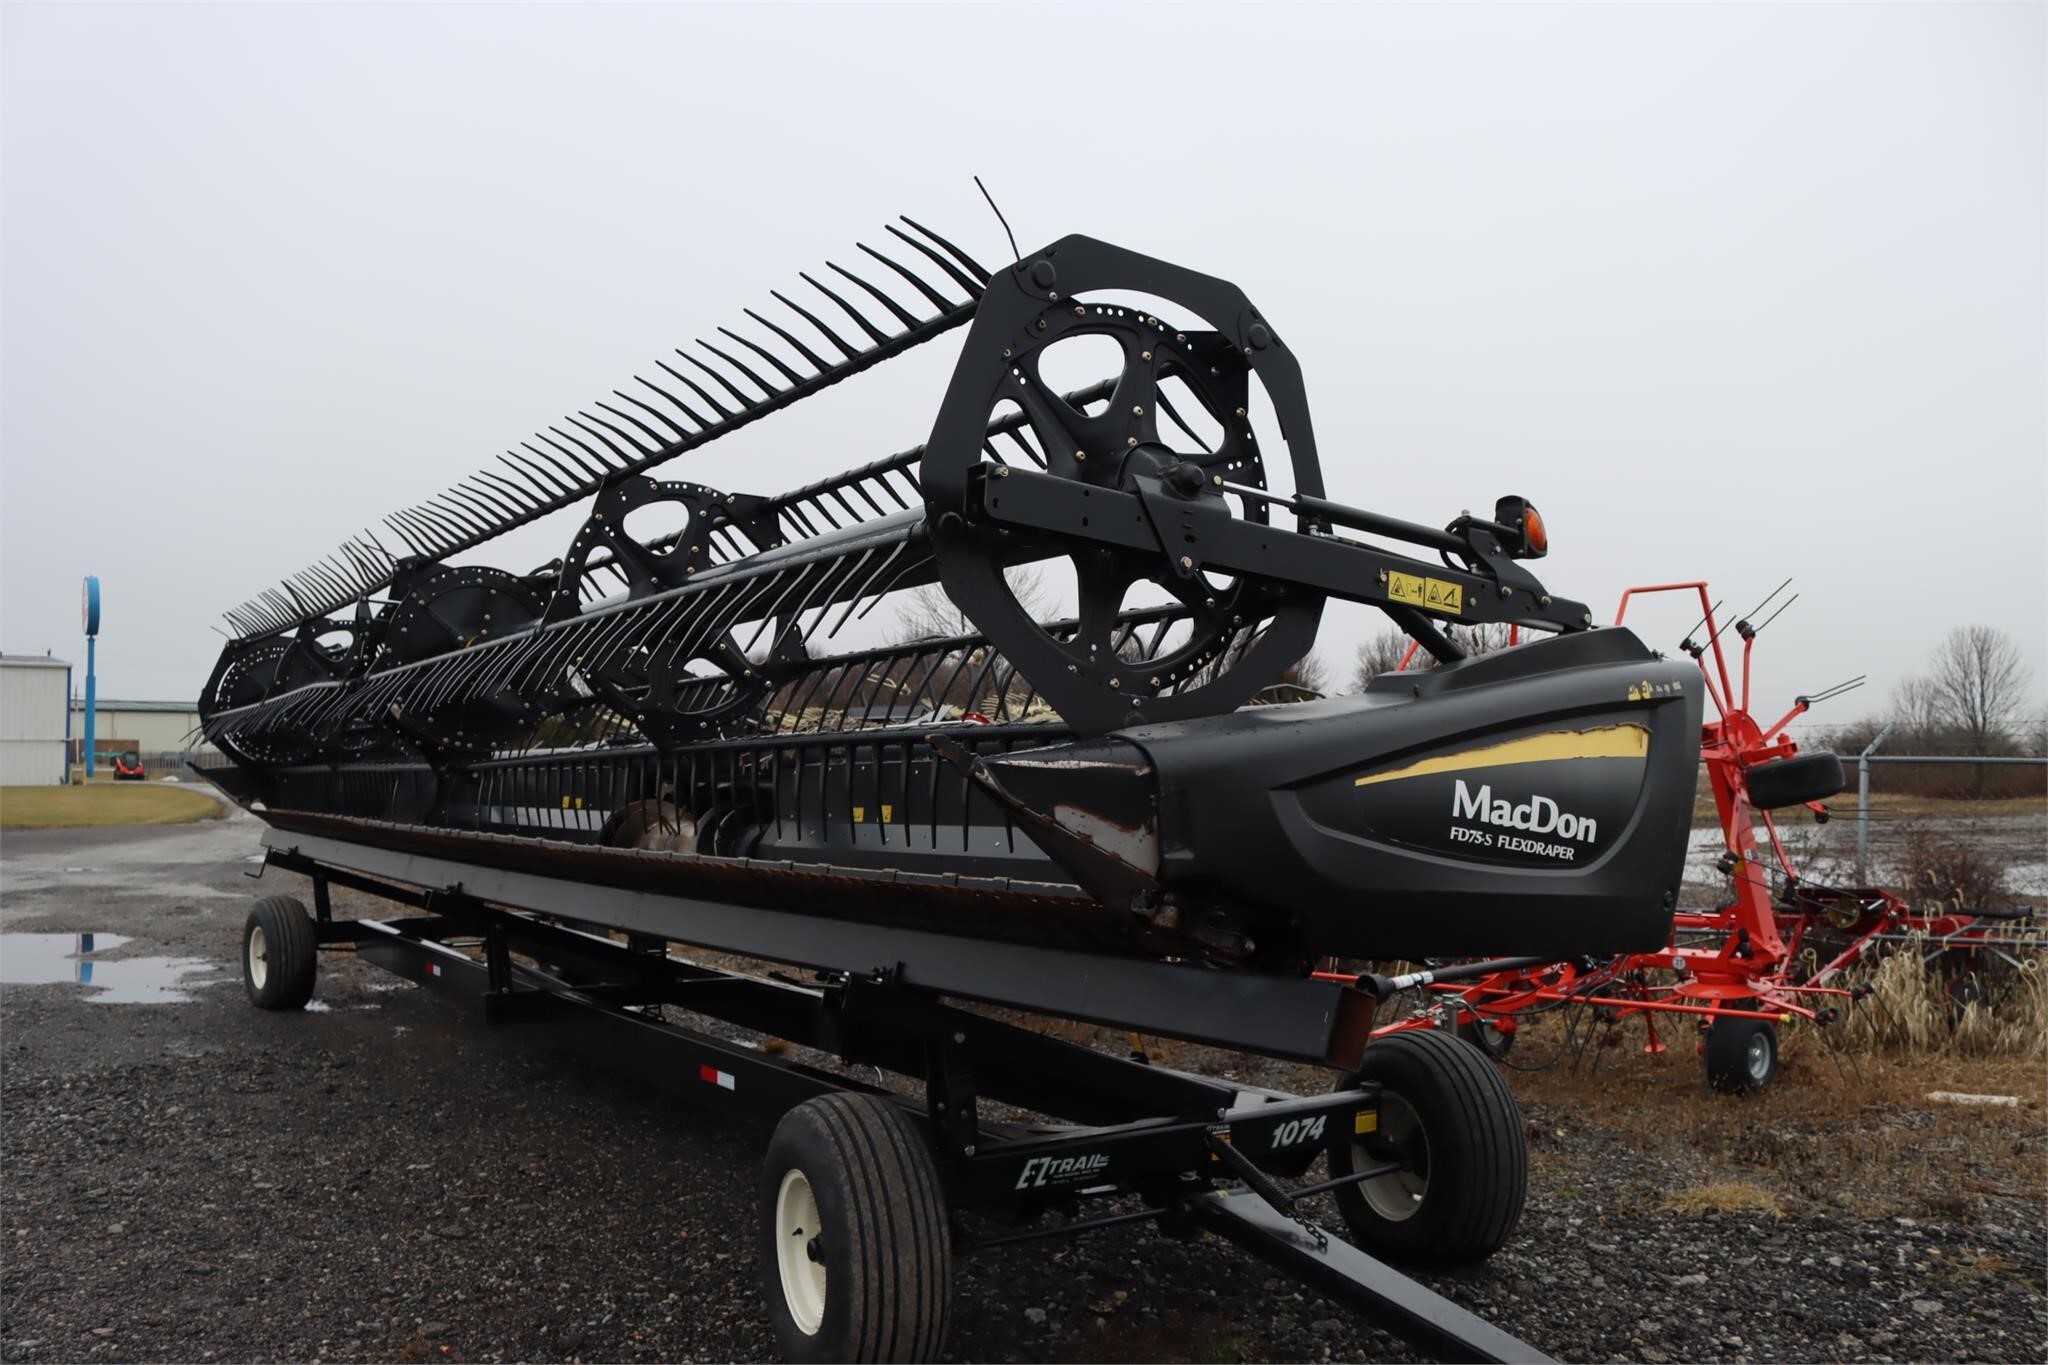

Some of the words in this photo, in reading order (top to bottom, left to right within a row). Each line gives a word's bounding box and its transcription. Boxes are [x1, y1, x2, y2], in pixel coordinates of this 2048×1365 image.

[1452, 779, 1597, 843] MacDon
[1450, 826, 1493, 846] FD75-S
[1498, 835, 1575, 860] FLEXDRAPER
[1272, 1115, 1328, 1149] 1074
